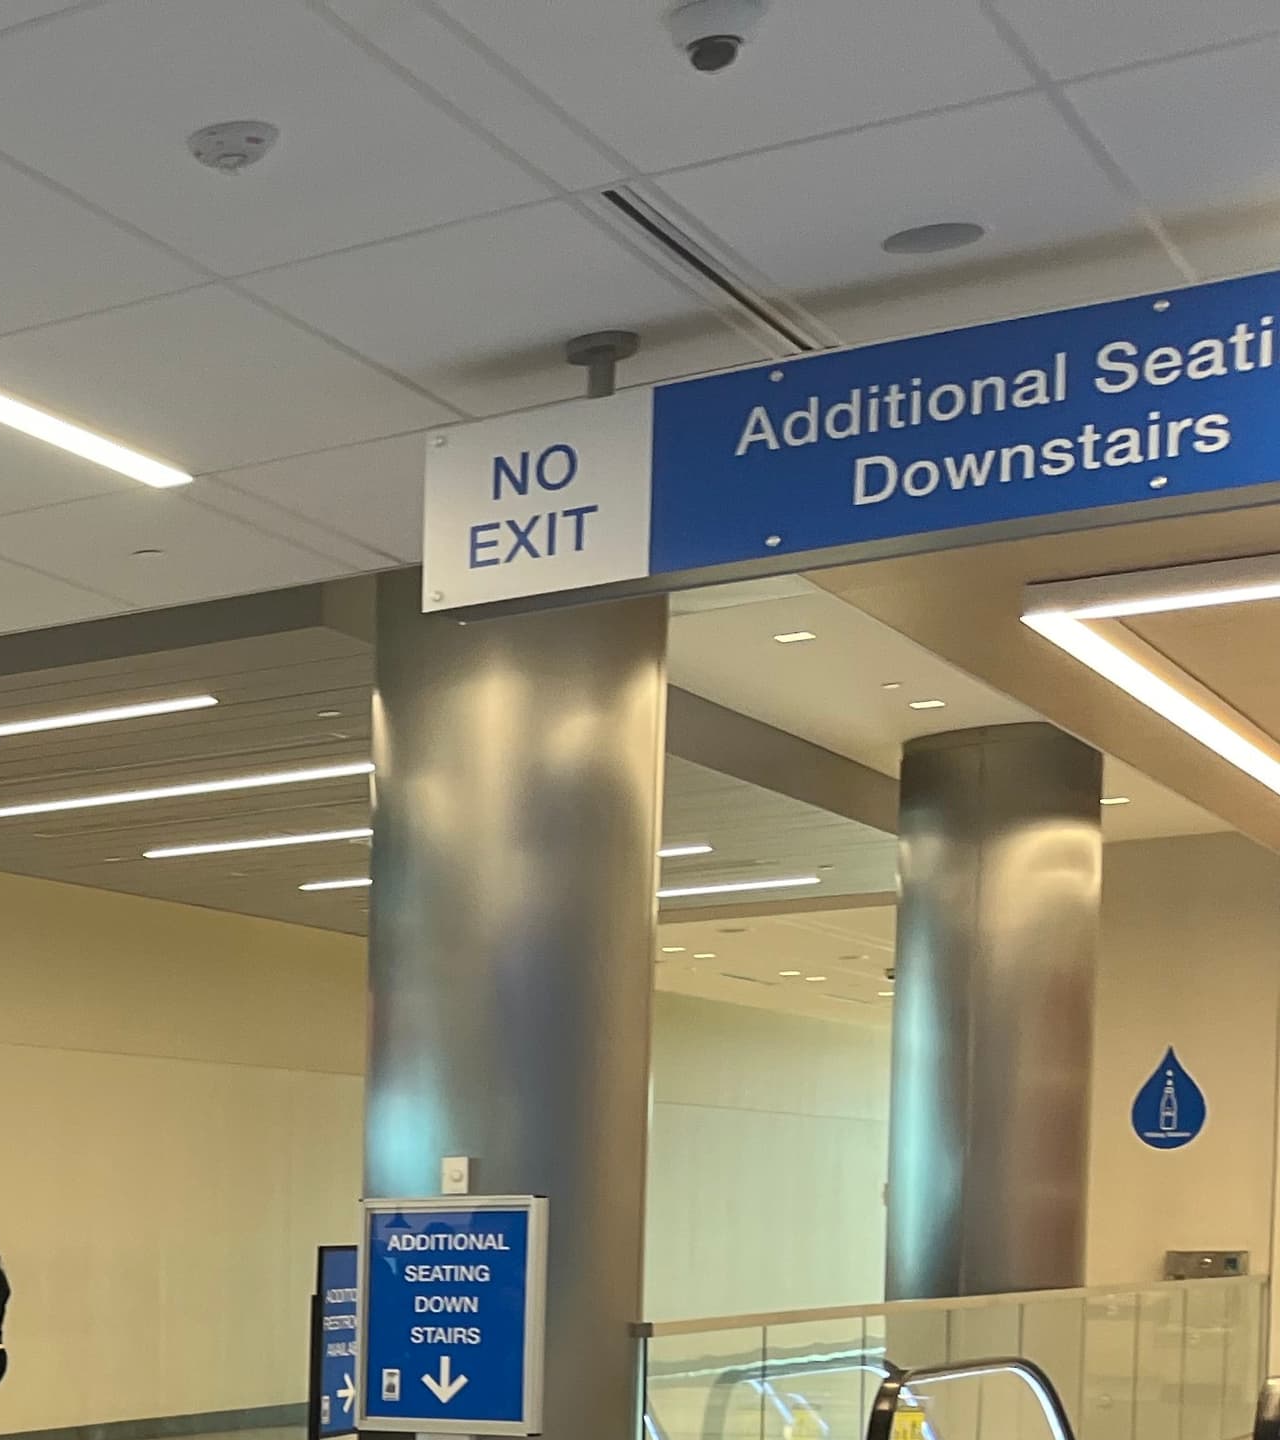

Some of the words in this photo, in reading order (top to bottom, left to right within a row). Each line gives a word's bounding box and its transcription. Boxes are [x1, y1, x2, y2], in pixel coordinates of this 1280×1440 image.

[734, 352, 1067, 456] Additional
[492, 443, 578, 501] NO
[851, 411, 1232, 506] Downstairs
[469, 504, 598, 569] EXIT
[387, 1233, 510, 1251] ADDITIONAL
[404, 1265, 490, 1282] SEATING
[414, 1296, 479, 1313] DOWN
[410, 1327, 481, 1345] STAIRS
